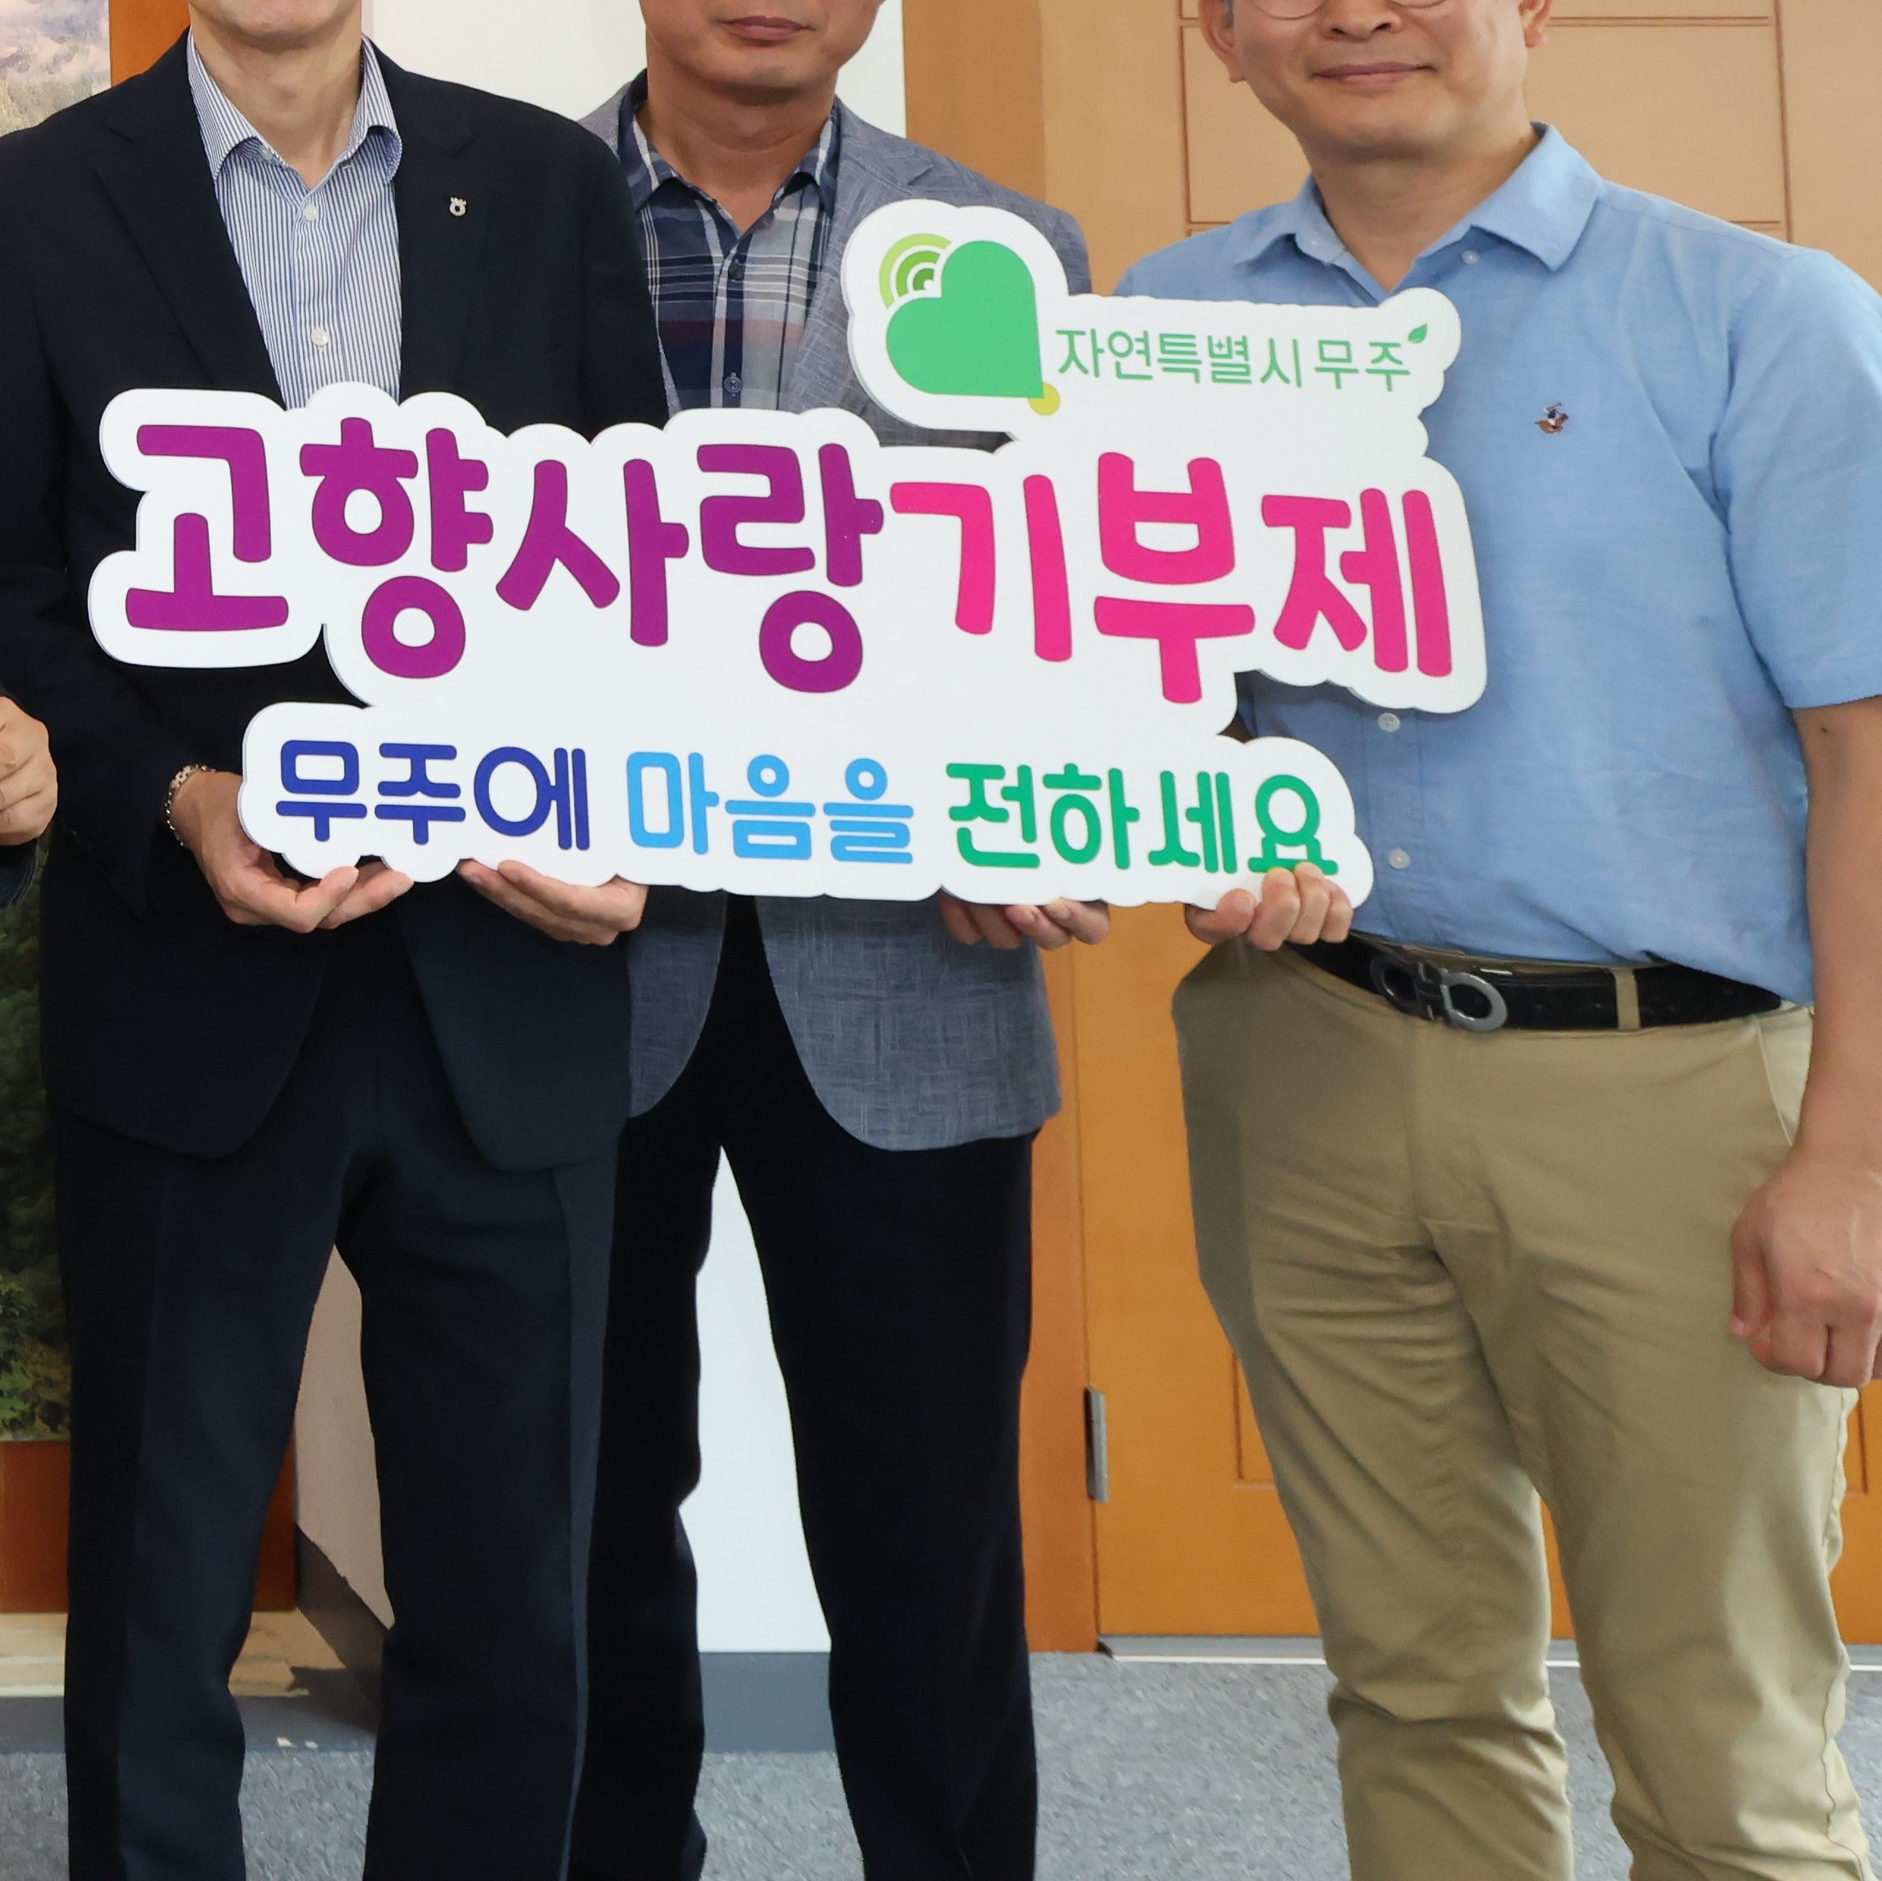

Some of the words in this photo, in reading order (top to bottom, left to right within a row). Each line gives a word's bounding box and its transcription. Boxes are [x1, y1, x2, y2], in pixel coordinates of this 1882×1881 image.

[277, 740, 589, 849] 무주에
[627, 752, 913, 863] 마음을
[947, 764, 1337, 874] 전하세요
